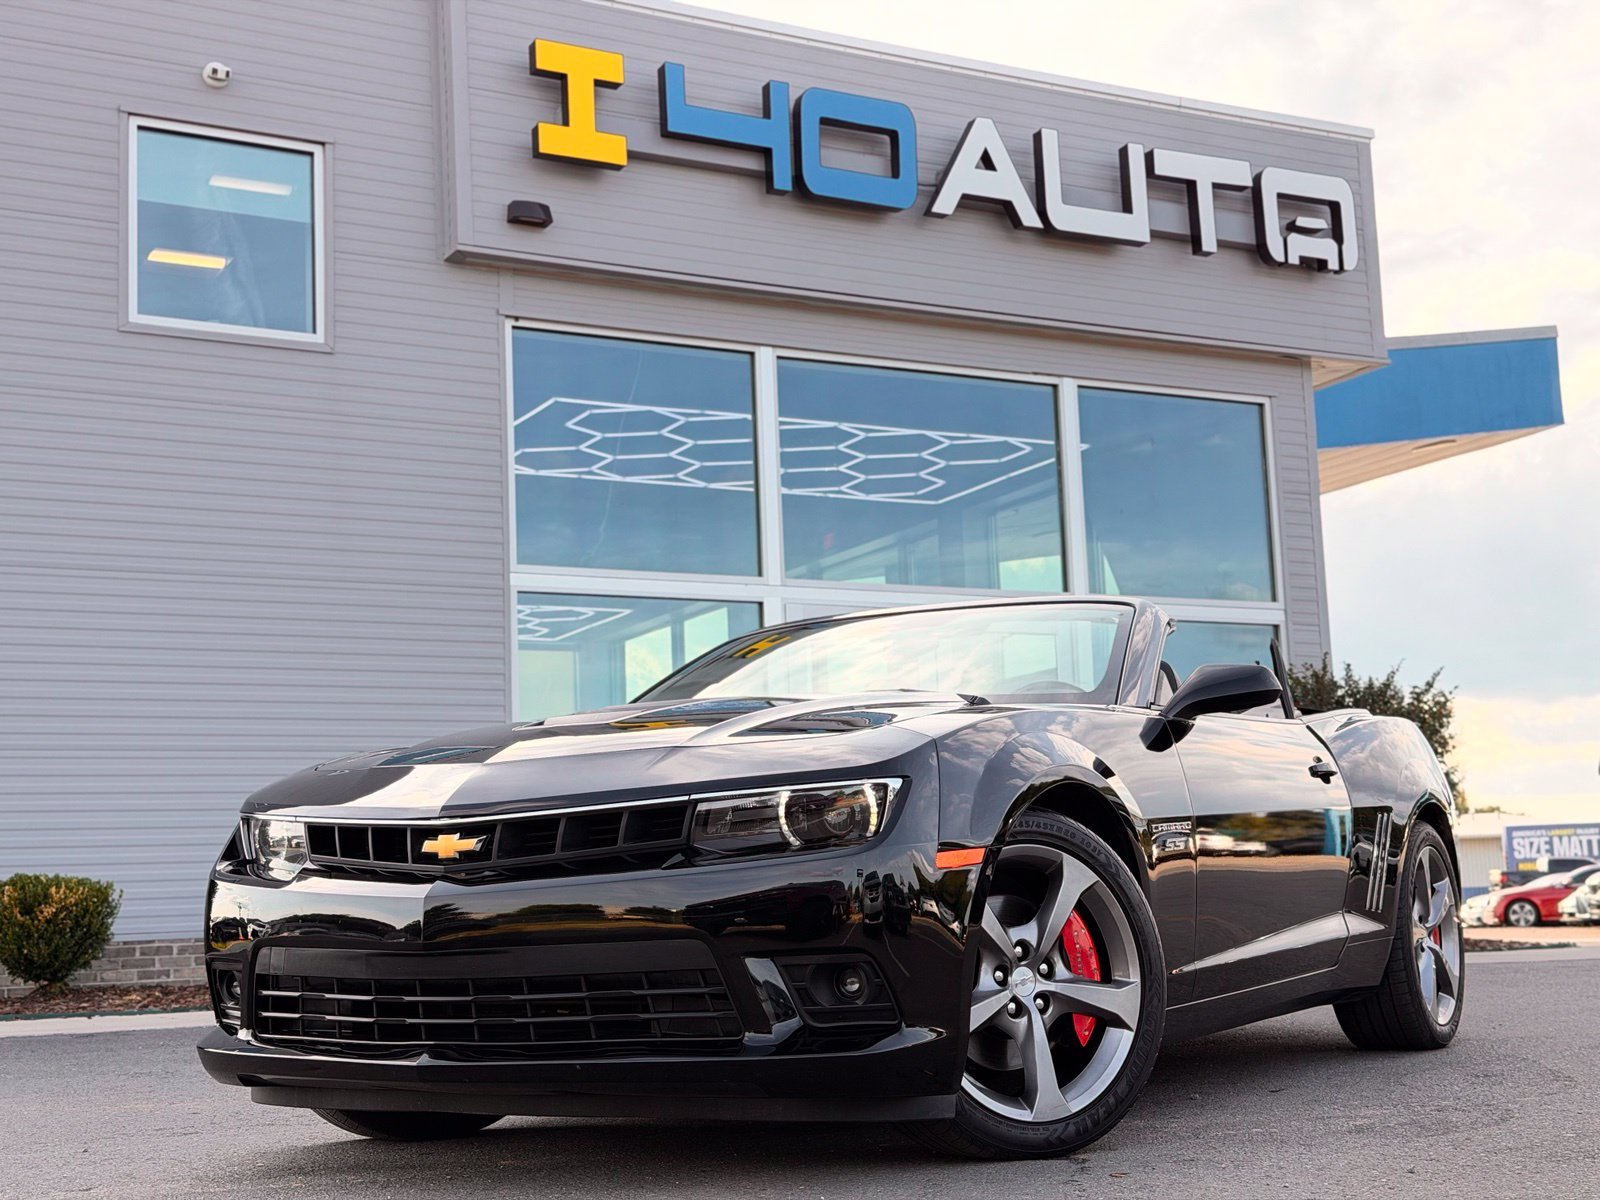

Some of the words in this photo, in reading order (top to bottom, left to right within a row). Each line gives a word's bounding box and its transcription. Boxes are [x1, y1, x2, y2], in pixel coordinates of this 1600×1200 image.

[1152, 821, 1192, 832] CAMARO
[1165, 837, 1188, 851] SS
[1512, 837, 1550, 859] SIZE
